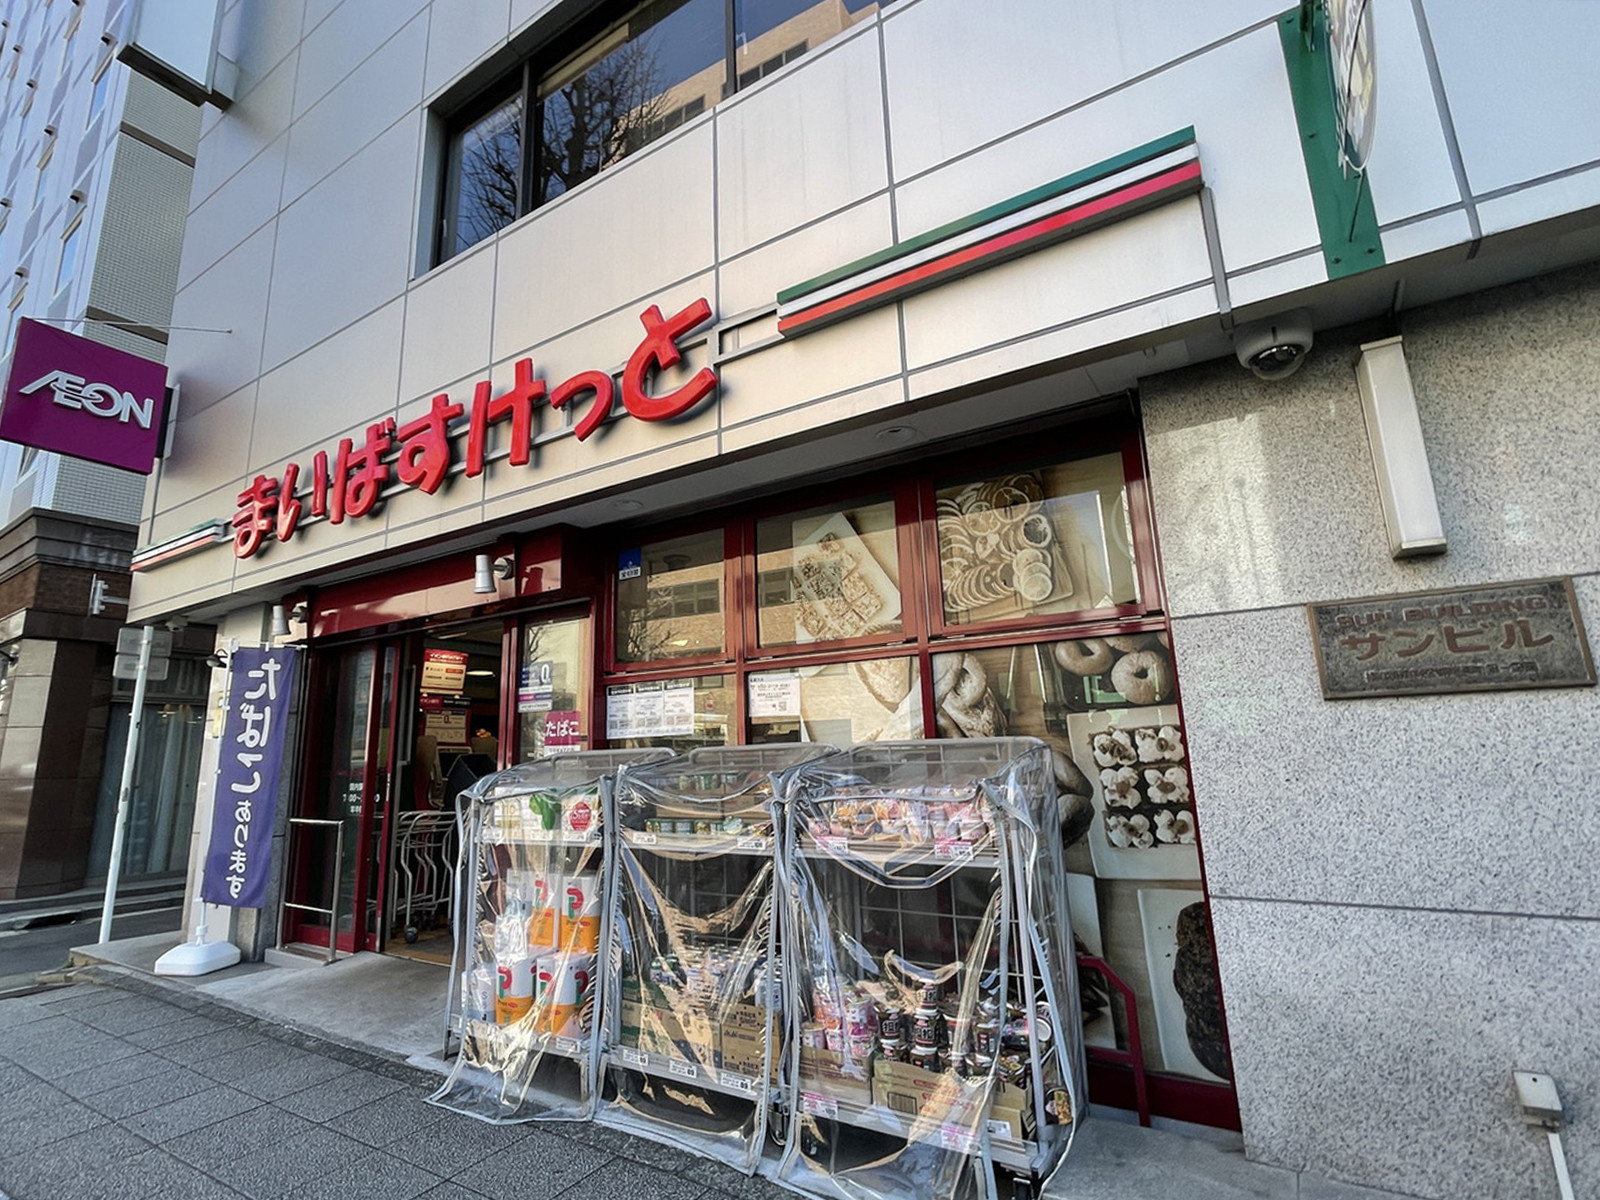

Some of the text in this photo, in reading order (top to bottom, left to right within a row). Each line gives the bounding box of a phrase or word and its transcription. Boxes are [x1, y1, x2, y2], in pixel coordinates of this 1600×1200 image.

[232, 297, 718, 560] まいばすけっと
[1335, 595, 1547, 628] SUN BUILDING
[1340, 617, 1554, 661] サンビル
[545, 719, 580, 737] たばこ
